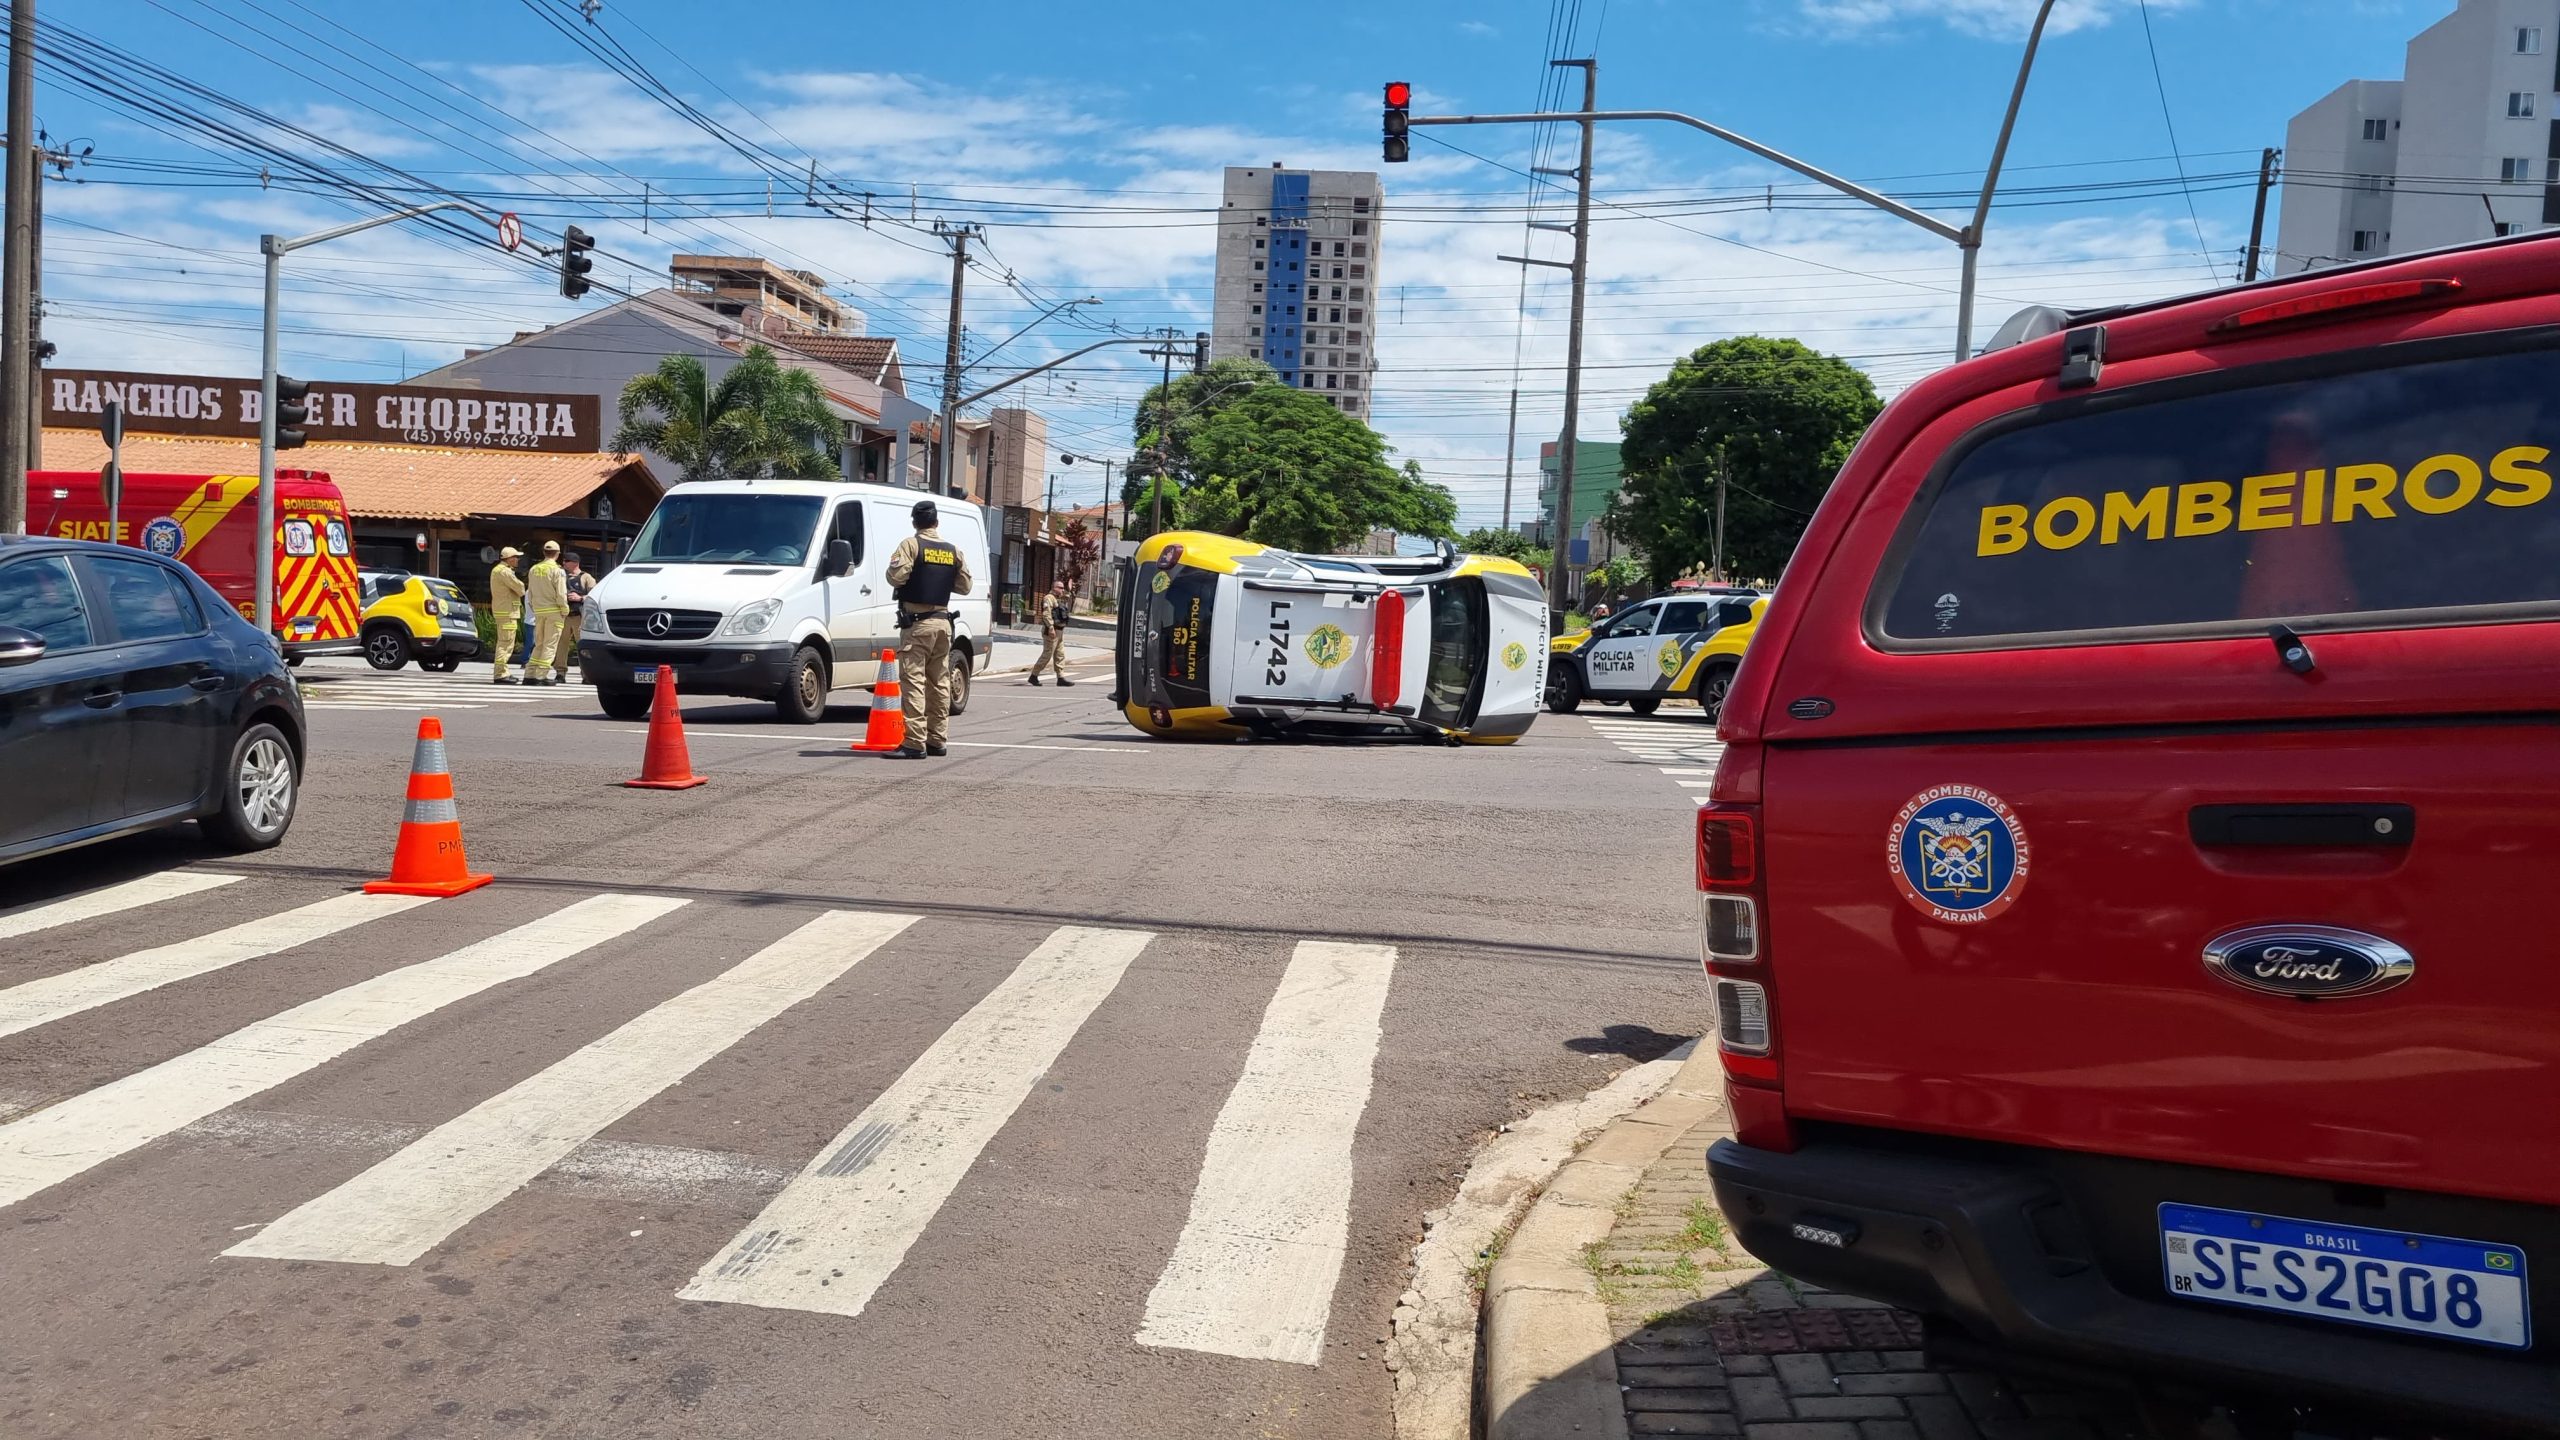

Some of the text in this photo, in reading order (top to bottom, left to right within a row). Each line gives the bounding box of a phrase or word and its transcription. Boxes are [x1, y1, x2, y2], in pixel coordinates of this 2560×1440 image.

[52, 378, 576, 437] RANCHOS BER CHOPERIA
[404, 429, 539, 448] (45) 99996-6622
[283, 498, 335, 511] BOMBEIROS
[1977, 446, 2553, 557] BOMBEIROS
[59, 521, 129, 540] SIATE
[924, 555, 954, 565] MILITAR
[1173, 626, 1181, 645] 190
[1187, 597, 1200, 680] POLÍCIA MILITAR
[1265, 601, 1291, 686] L1742
[1593, 650, 1634, 660] POLÍCIA
[1593, 662, 1634, 671] MILITAR
[1888, 785, 2029, 876] CORPO DE BOMBEIROS MILITAR
[1932, 908, 1987, 922] PARANÁ
[2254, 946, 2343, 981] Ford
[2304, 1233, 2361, 1252] BRASIL
[2174, 1275, 2193, 1291] BR
[2193, 1239, 2483, 1329] SES2G08
